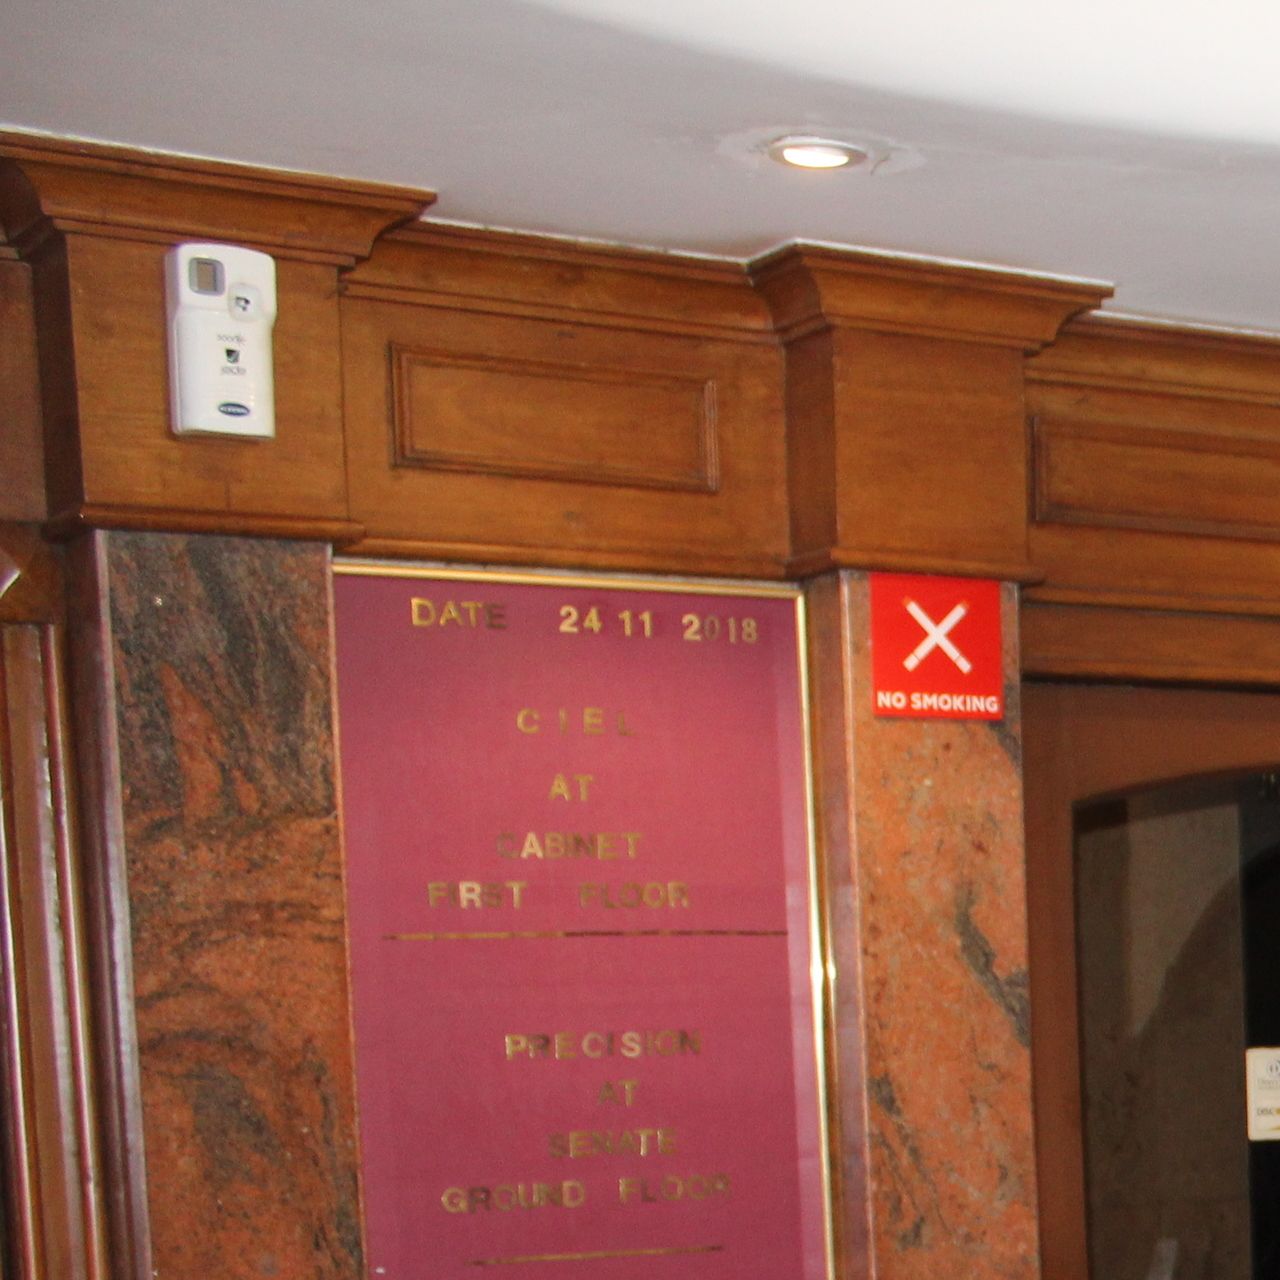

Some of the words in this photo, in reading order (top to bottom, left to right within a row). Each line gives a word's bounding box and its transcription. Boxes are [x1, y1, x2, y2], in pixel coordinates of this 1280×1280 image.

[411, 597, 507, 629] DATE
[559, 605, 600, 633] 24
[619, 611, 654, 637] 11
[682, 614, 758, 643] 2018
[877, 691, 906, 708] NO
[910, 692, 999, 714] SMOKING
[516, 707, 637, 737] CIEL
[548, 773, 594, 802] AT
[496, 831, 643, 860] CABINET
[426, 881, 527, 909] FIRST
[578, 881, 691, 908] FLOOR
[504, 1029, 703, 1060] PRECISION
[596, 1079, 639, 1107] AT
[548, 1128, 677, 1159] SENATE
[441, 1180, 585, 1213] GROUND
[618, 1174, 730, 1204] FLOOR
